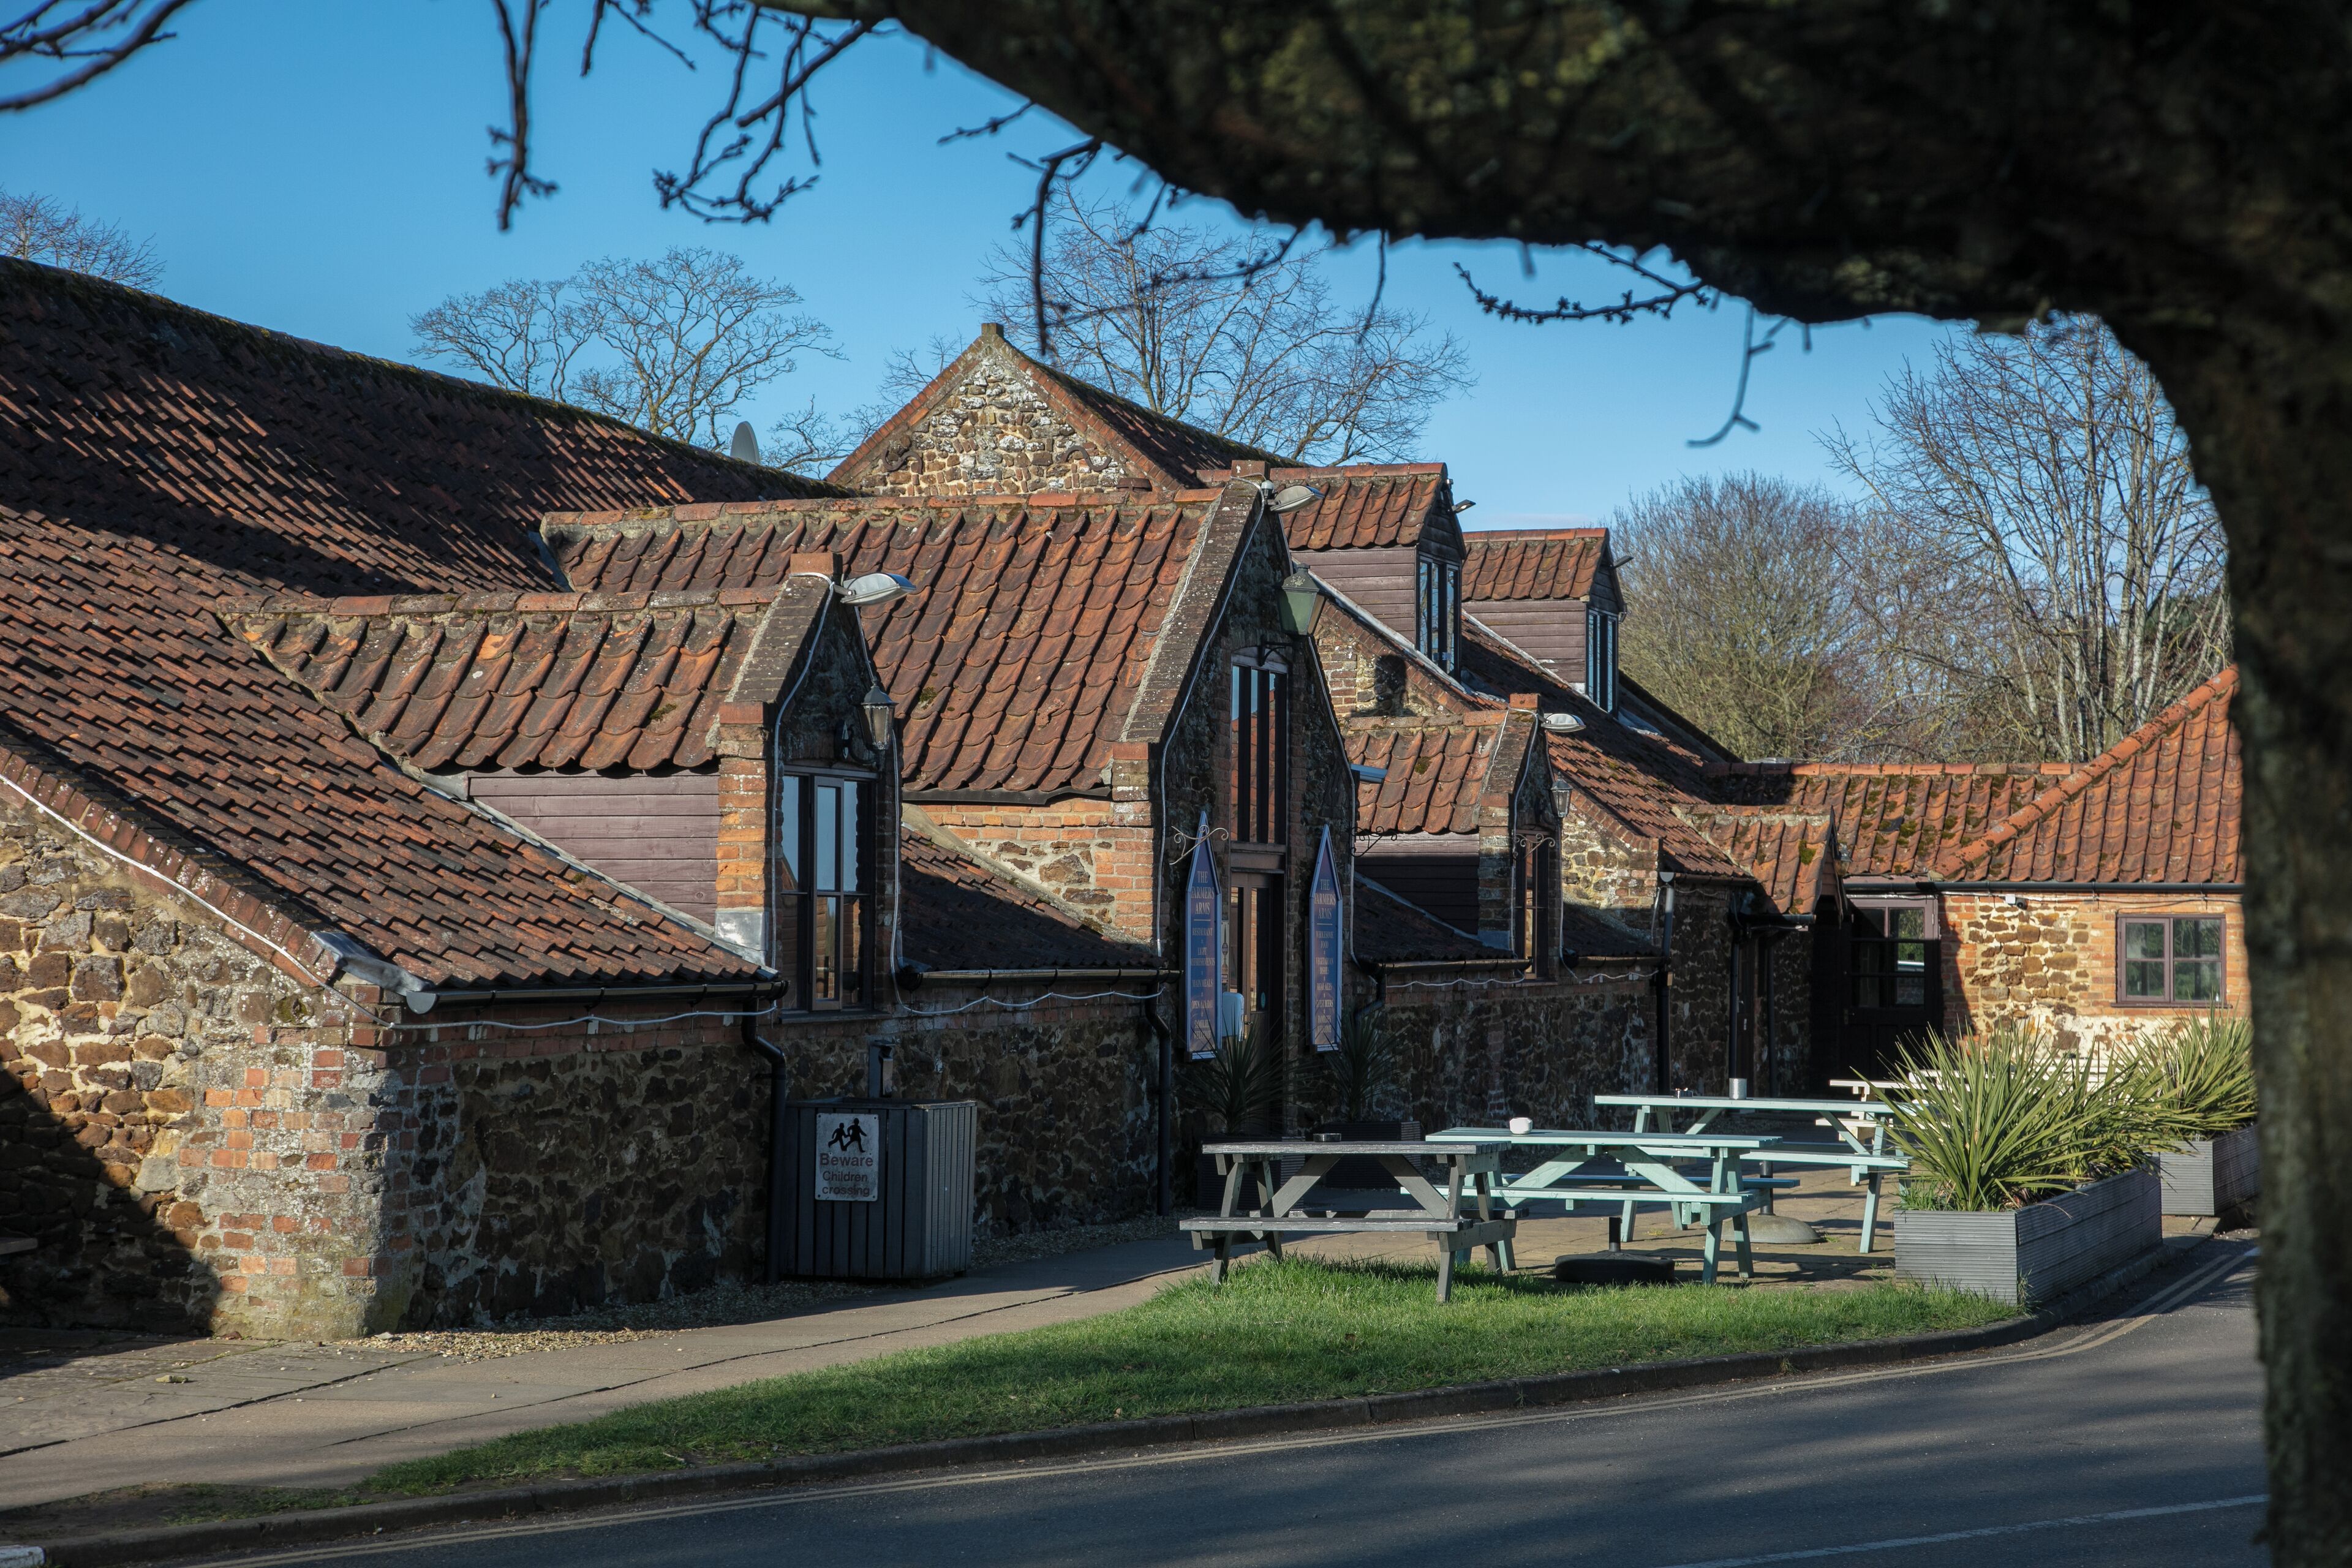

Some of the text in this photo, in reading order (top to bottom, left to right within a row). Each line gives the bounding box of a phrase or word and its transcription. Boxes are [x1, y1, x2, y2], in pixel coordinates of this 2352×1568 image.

[1197, 871, 1208, 883] THE
[1320, 879, 1330, 891] THE
[1191, 886, 1215, 899] FARMERS
[1314, 893, 1336, 905] FARMERS
[1196, 902, 1210, 914] ARMS
[1318, 908, 1332, 919] ARMS
[1192, 927, 1213, 936] RESTAURANT
[1191, 1000, 1200, 1009] OPEN
[820, 1153, 873, 1166] Beware
[823, 1170, 868, 1181] Children
[822, 1186, 870, 1197] crossing
